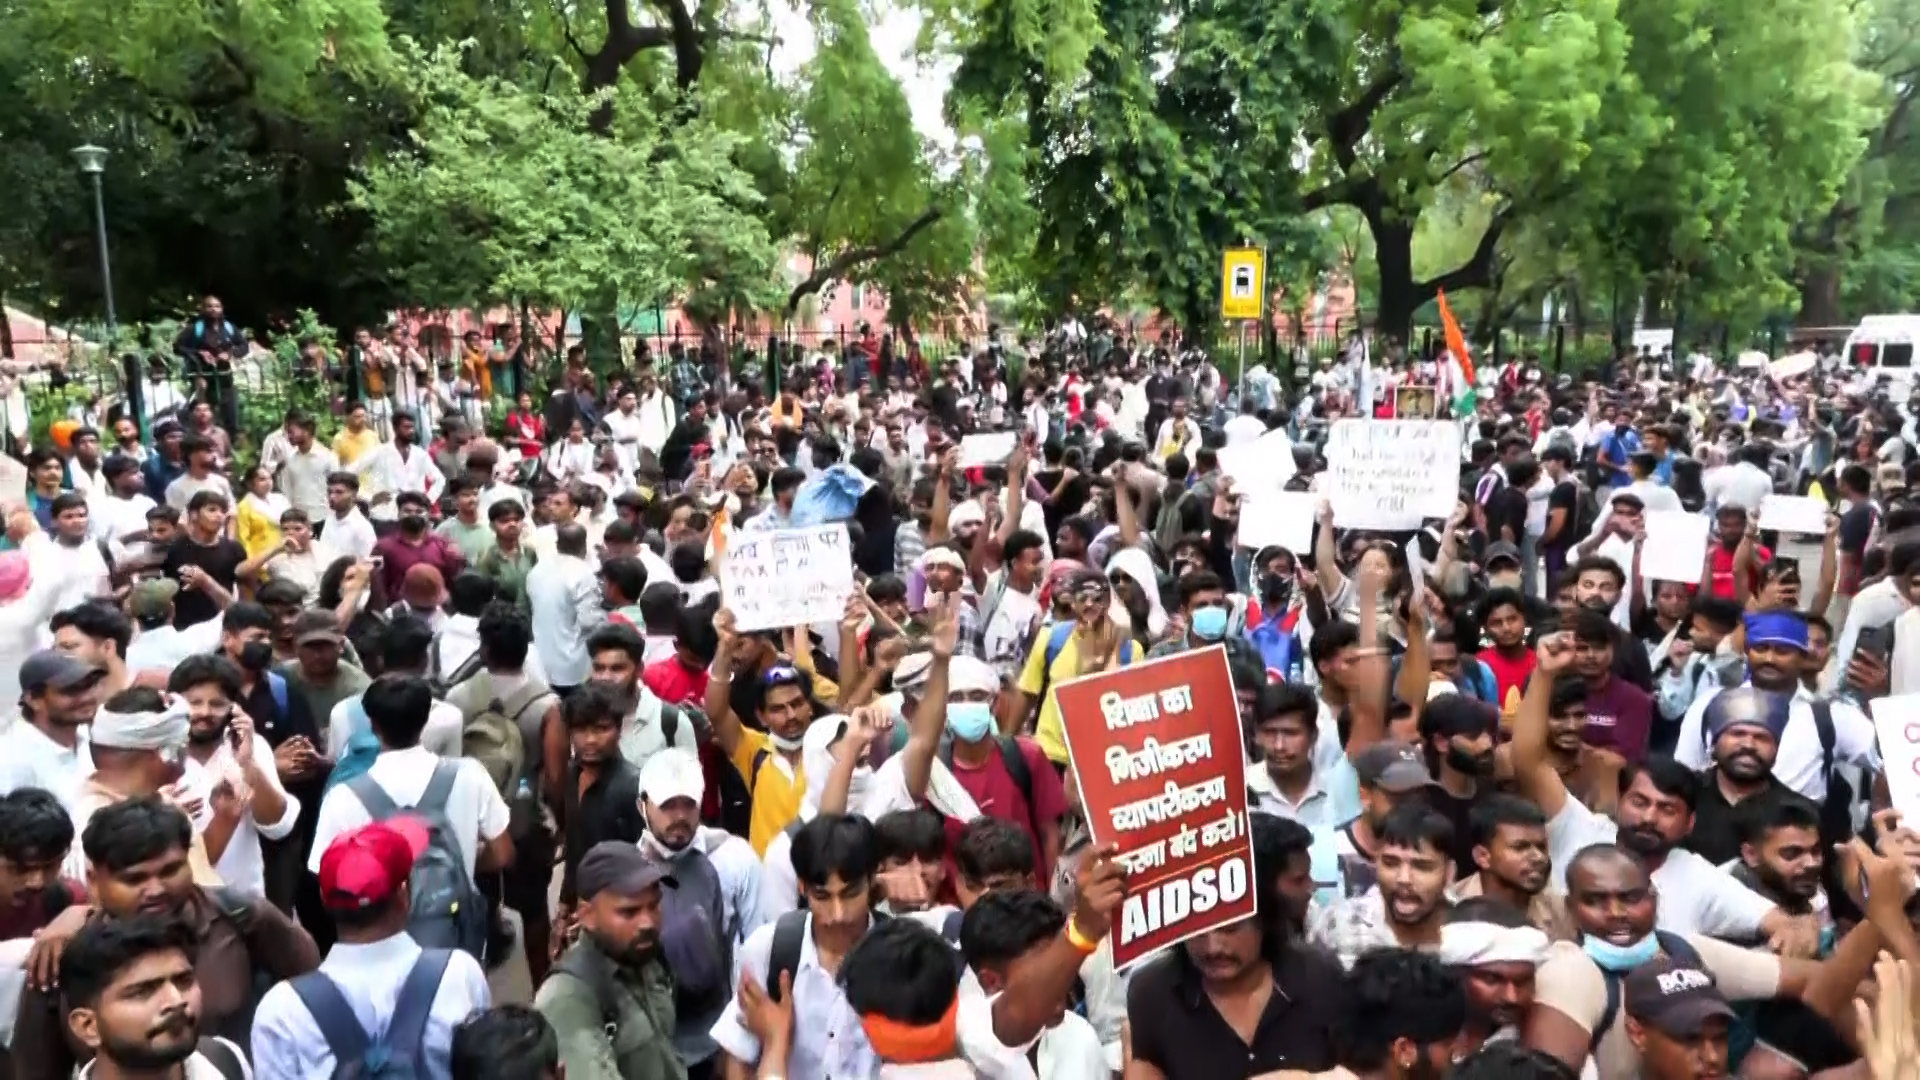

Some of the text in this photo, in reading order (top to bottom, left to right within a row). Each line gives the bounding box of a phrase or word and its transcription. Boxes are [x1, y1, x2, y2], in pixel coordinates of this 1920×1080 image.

[1100, 683, 1194, 731] शिक्षा का
[1105, 734, 1213, 785] निजीकरण
[1168, 822, 1199, 859] बंद
[1120, 857, 1248, 946] AIDSO
